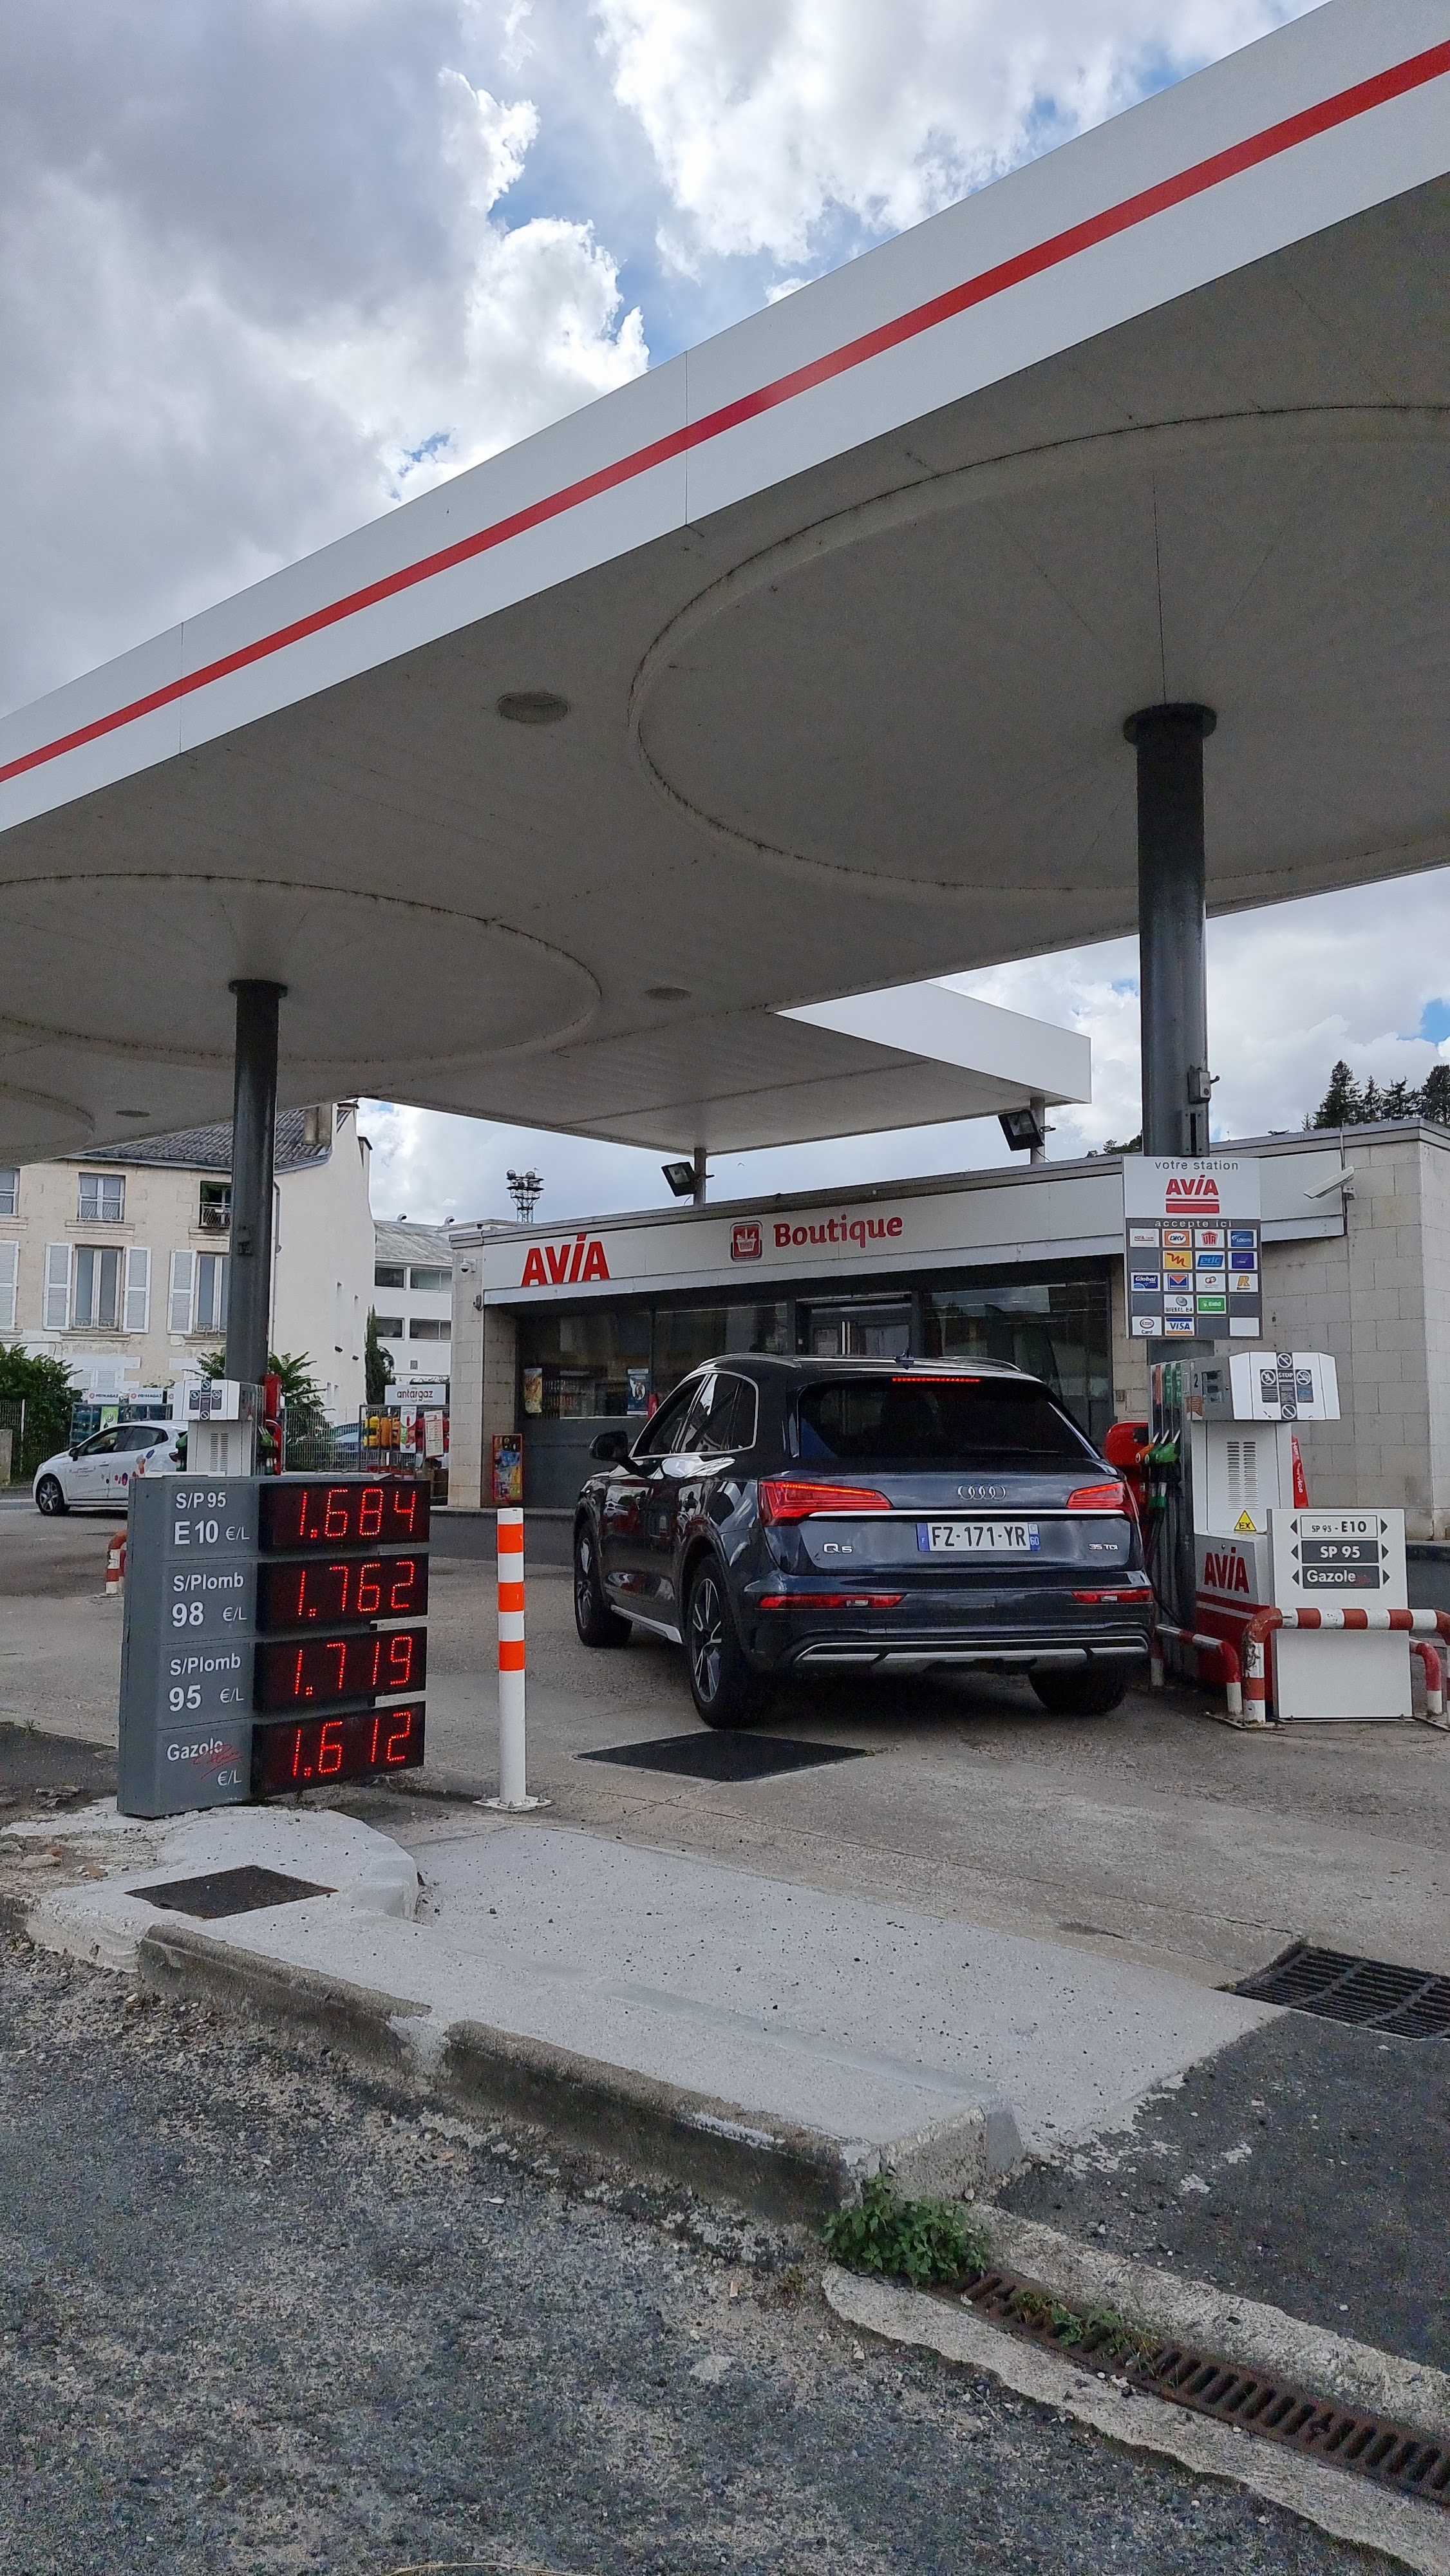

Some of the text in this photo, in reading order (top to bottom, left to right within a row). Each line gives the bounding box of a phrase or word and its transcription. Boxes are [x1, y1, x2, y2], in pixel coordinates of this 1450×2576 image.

[1155, 1160, 1238, 1170] votre station
[1165, 1174, 1219, 1196] AVIA
[773, 1214, 903, 1248] Boutique
[1154, 1220, 1209, 1229] accepte
[1203, 1233, 1217, 1244] UTA
[521, 1233, 610, 1287] AVIA
[1169, 1322, 1191, 1331] VISA
[1194, 1373, 1199, 1388] 2
[397, 1388, 433, 1401] antargaz
[299, 1488, 417, 1539] 1.684
[225, 1526, 250, 1541] €/L
[932, 1526, 1027, 1547] FZ-171-YR
[1312, 1524, 1320, 1533] SP
[1030, 1537, 1040, 1546] 60
[1320, 1546, 1361, 1558] SP 95
[1203, 1546, 1250, 1594] AVIA
[1306, 1569, 1357, 1583] Gazole
[173, 1571, 244, 1592] S/Plomb
[297, 1560, 416, 1618] 1.762
[172, 1601, 248, 1627] 98 €/L
[169, 1653, 241, 1676] S/Plomb
[169, 1684, 245, 1712] 95 €/L
[217, 1769, 242, 1786] €/L
